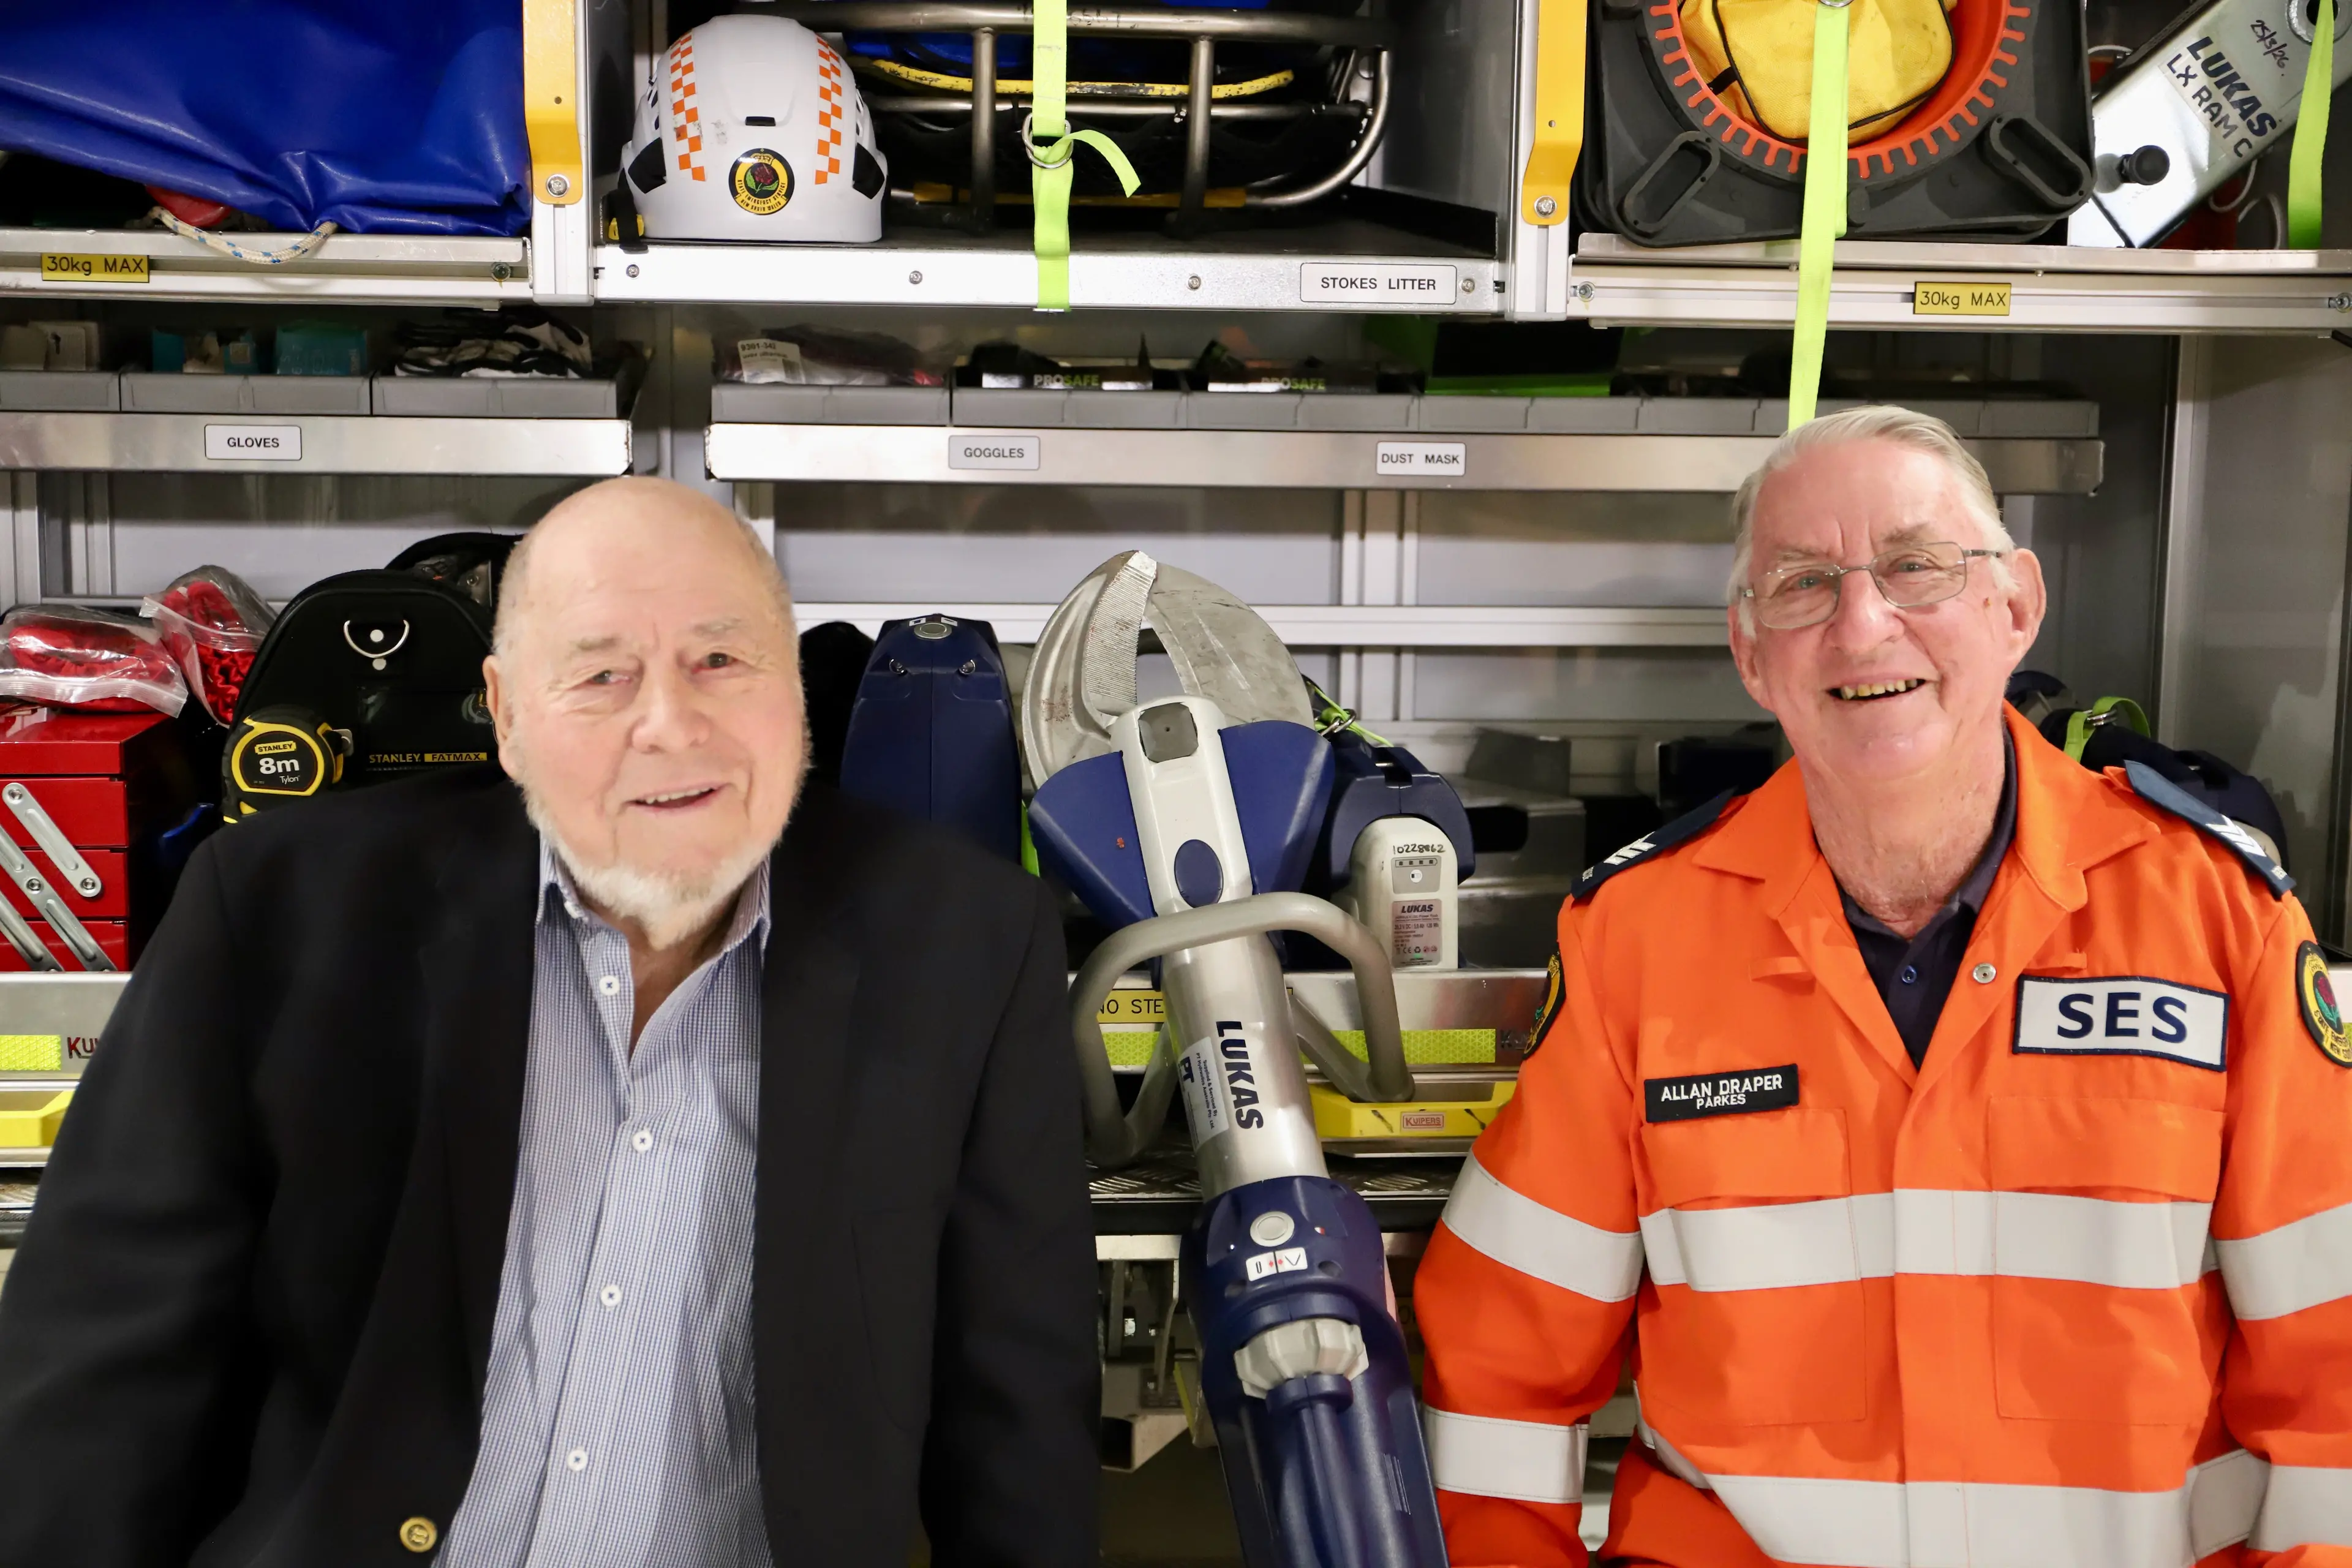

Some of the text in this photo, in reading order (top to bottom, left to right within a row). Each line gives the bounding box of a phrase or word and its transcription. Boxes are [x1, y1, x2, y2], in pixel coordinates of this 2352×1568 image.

[2187, 36, 2277, 137] LUKAS
[2167, 53, 2252, 157] LX RAM C
[47, 255, 144, 276] 30kg MAX
[1321, 277, 1436, 290] STOKES LITTER
[1920, 292, 2007, 310] 30kg MAX
[1033, 374, 1100, 386] PROSAFE
[227, 436, 280, 448] GLOVES
[963, 447, 1025, 459] GOGGLES
[1381, 453, 1460, 465] DUST MASK
[258, 744, 293, 753] STANLEY
[259, 756, 300, 775] 8m
[369, 753, 481, 763] STANLEY FATMAX
[279, 775, 300, 785] Tylon
[1401, 904, 1434, 913] LUKAS
[1131, 999, 1164, 1014] STE
[2056, 991, 2188, 1044] SES
[67, 1037, 98, 1058] KU
[1180, 1057, 1194, 1083] PT
[1216, 1020, 1264, 1129] LUKAS
[1660, 1074, 1783, 1102] ALLAN DRAPER
[1696, 1094, 1746, 1110] PARKES
[1406, 1117, 1442, 1126] KUIPERS
